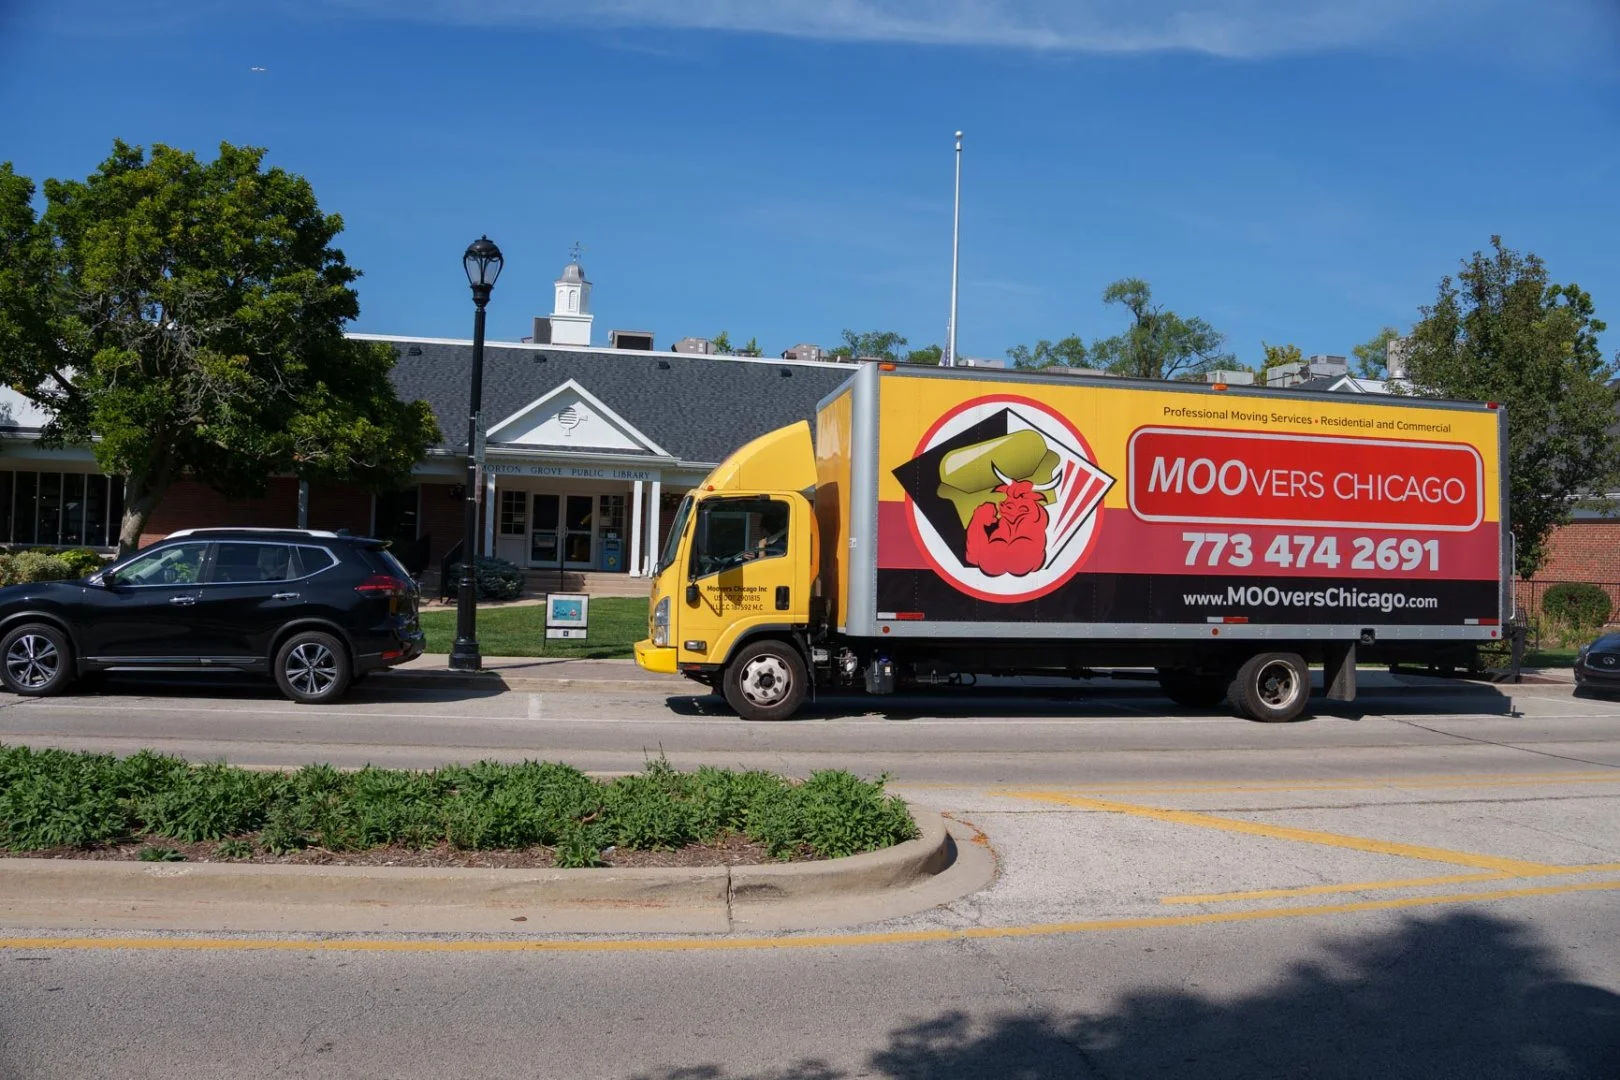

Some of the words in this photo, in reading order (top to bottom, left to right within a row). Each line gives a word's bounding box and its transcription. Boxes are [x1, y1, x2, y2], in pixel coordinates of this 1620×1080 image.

[1163, 406, 1228, 420] Professional
[1231, 410, 1268, 424] Moving
[1270, 413, 1313, 426] Services
[1320, 416, 1374, 430] Residential
[1376, 419, 1394, 430] and
[1396, 420, 1452, 434] Commercial
[530, 467, 562, 476] GROVE
[571, 469, 604, 478] PUBLIC
[612, 470, 650, 480] LIBRARY
[1333, 472, 1466, 505] CHICAGO
[1182, 532, 1253, 567] 773
[1264, 534, 1341, 569] 474
[1351, 537, 1440, 571] 2691
[733, 585, 757, 593] Chicago
[1183, 586, 1438, 612] www.MOOversChicago.com
